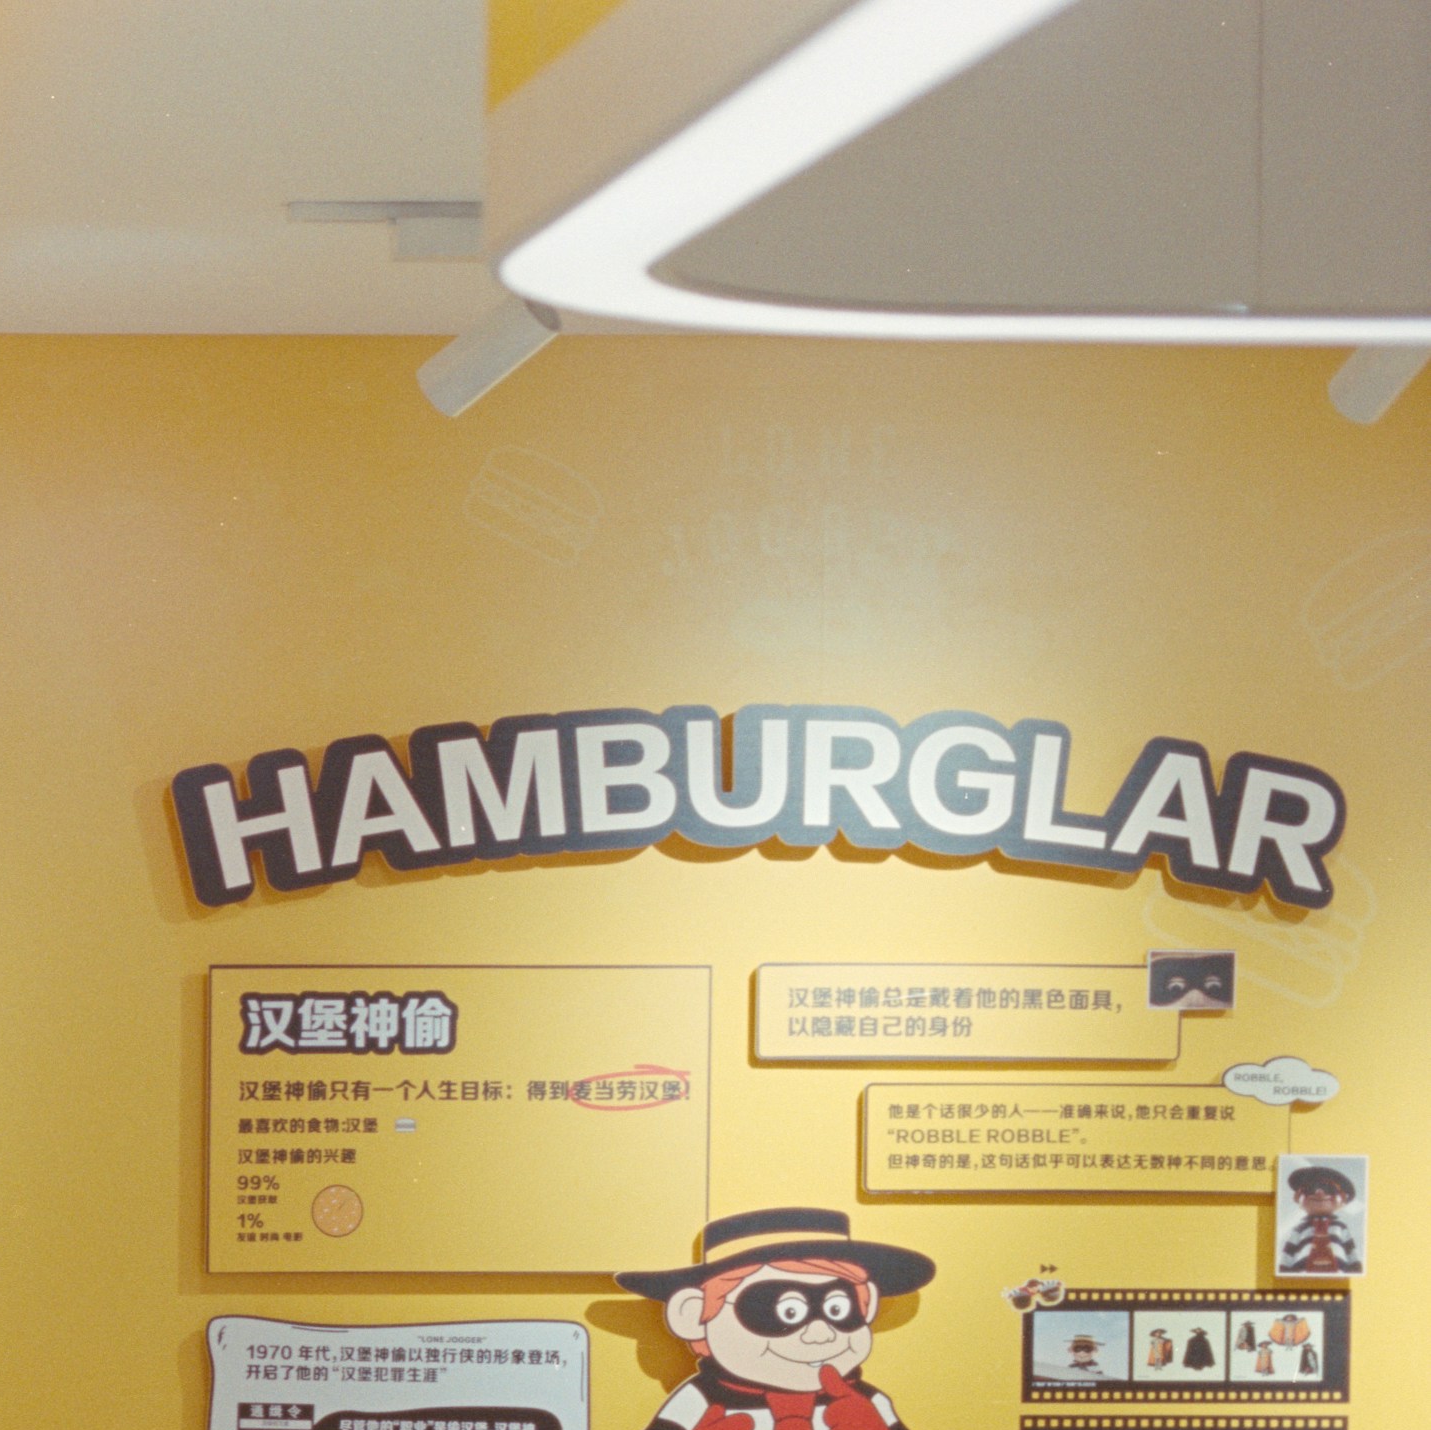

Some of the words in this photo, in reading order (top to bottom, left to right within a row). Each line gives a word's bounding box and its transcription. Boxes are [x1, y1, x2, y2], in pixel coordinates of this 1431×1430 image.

[202, 717, 1338, 893] HAMBURGLAR
[787, 987, 1123, 1013] 汉堡神偷总是戴着他的黑色面具，
[245, 996, 453, 1049] 汉堡神偷
[787, 1015, 973, 1038] 以隐藏自己的身份
[238, 1148, 357, 1165] 汉堡神偷的兴趣
[237, 1175, 280, 1191] 99%
[237, 1213, 264, 1229] 1%
[246, 1345, 292, 1361] 1970
